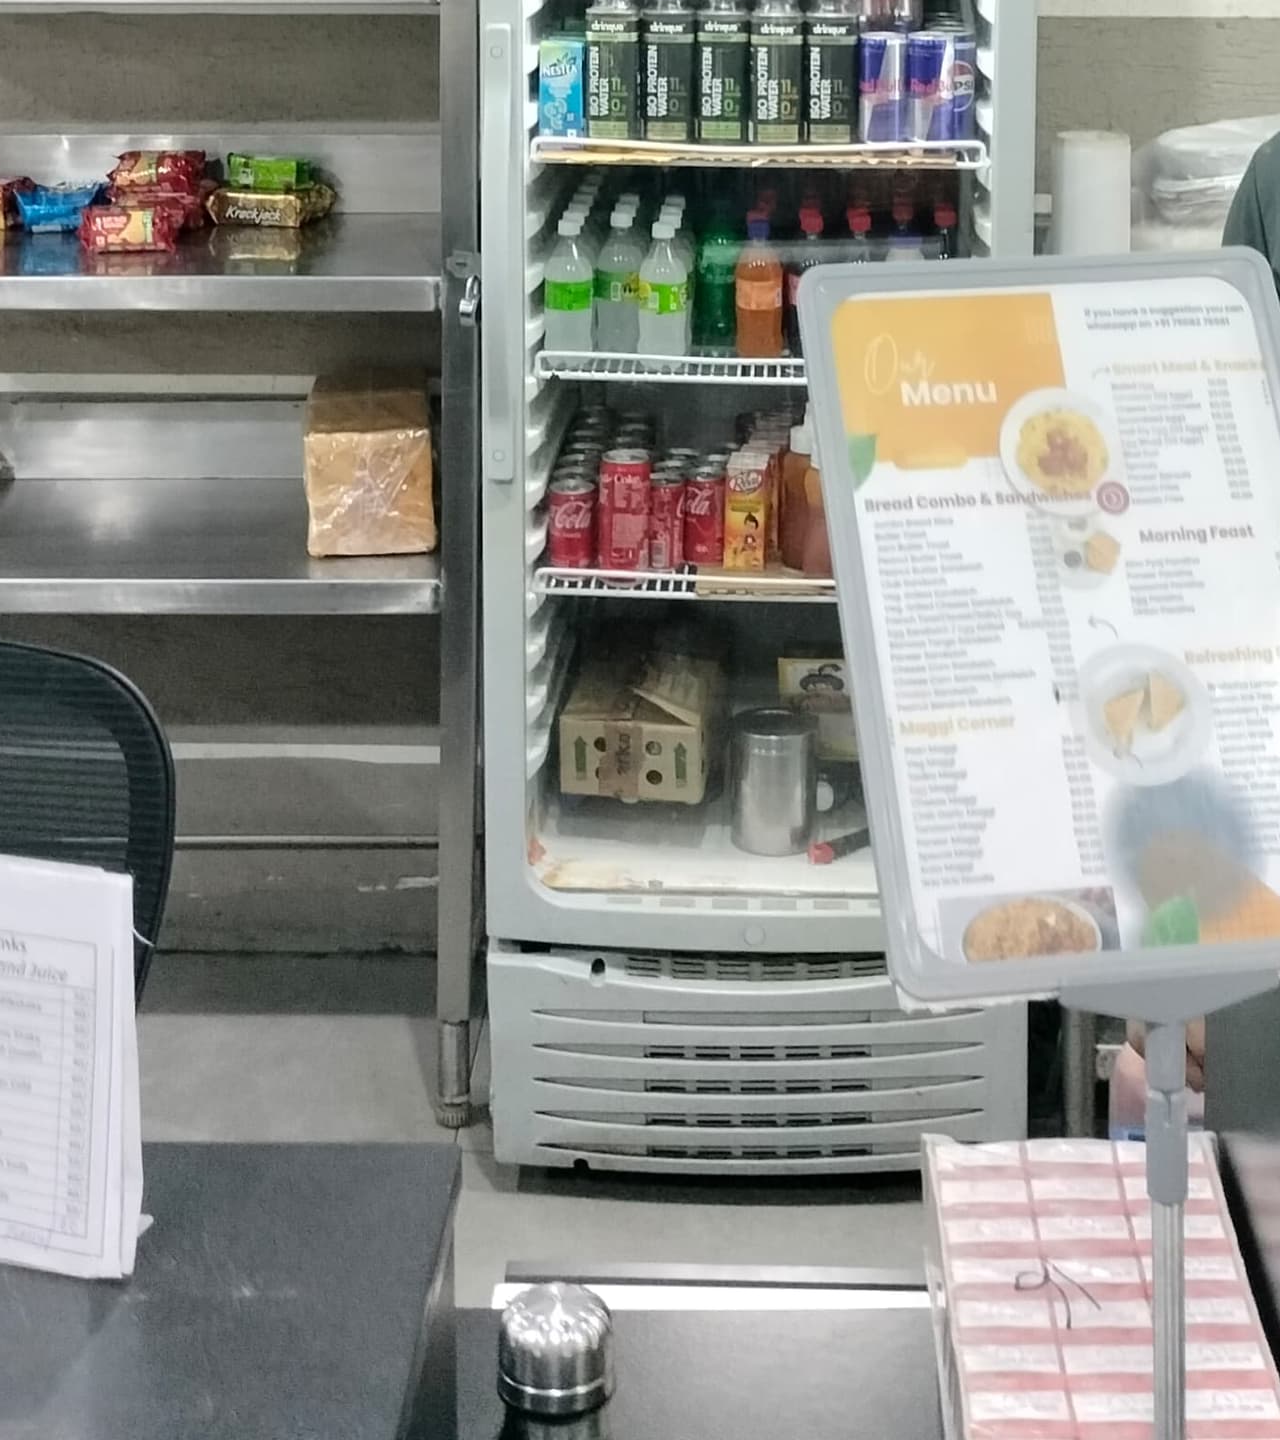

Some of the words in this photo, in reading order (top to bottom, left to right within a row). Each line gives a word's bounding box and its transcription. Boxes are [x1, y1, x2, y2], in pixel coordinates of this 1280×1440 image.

[225, 205, 282, 225] Krackjack
[899, 379, 998, 408] Menu
[864, 494, 914, 514] Bread
[916, 491, 977, 511] Combo
[980, 491, 992, 506] &
[1139, 525, 1208, 544] Morning
[1209, 524, 1255, 540] Feast
[1183, 646, 1274, 665] Refreshing
[899, 717, 953, 738] Maggi
[958, 715, 1015, 732] Corner
[30, 962, 69, 982] Juice
